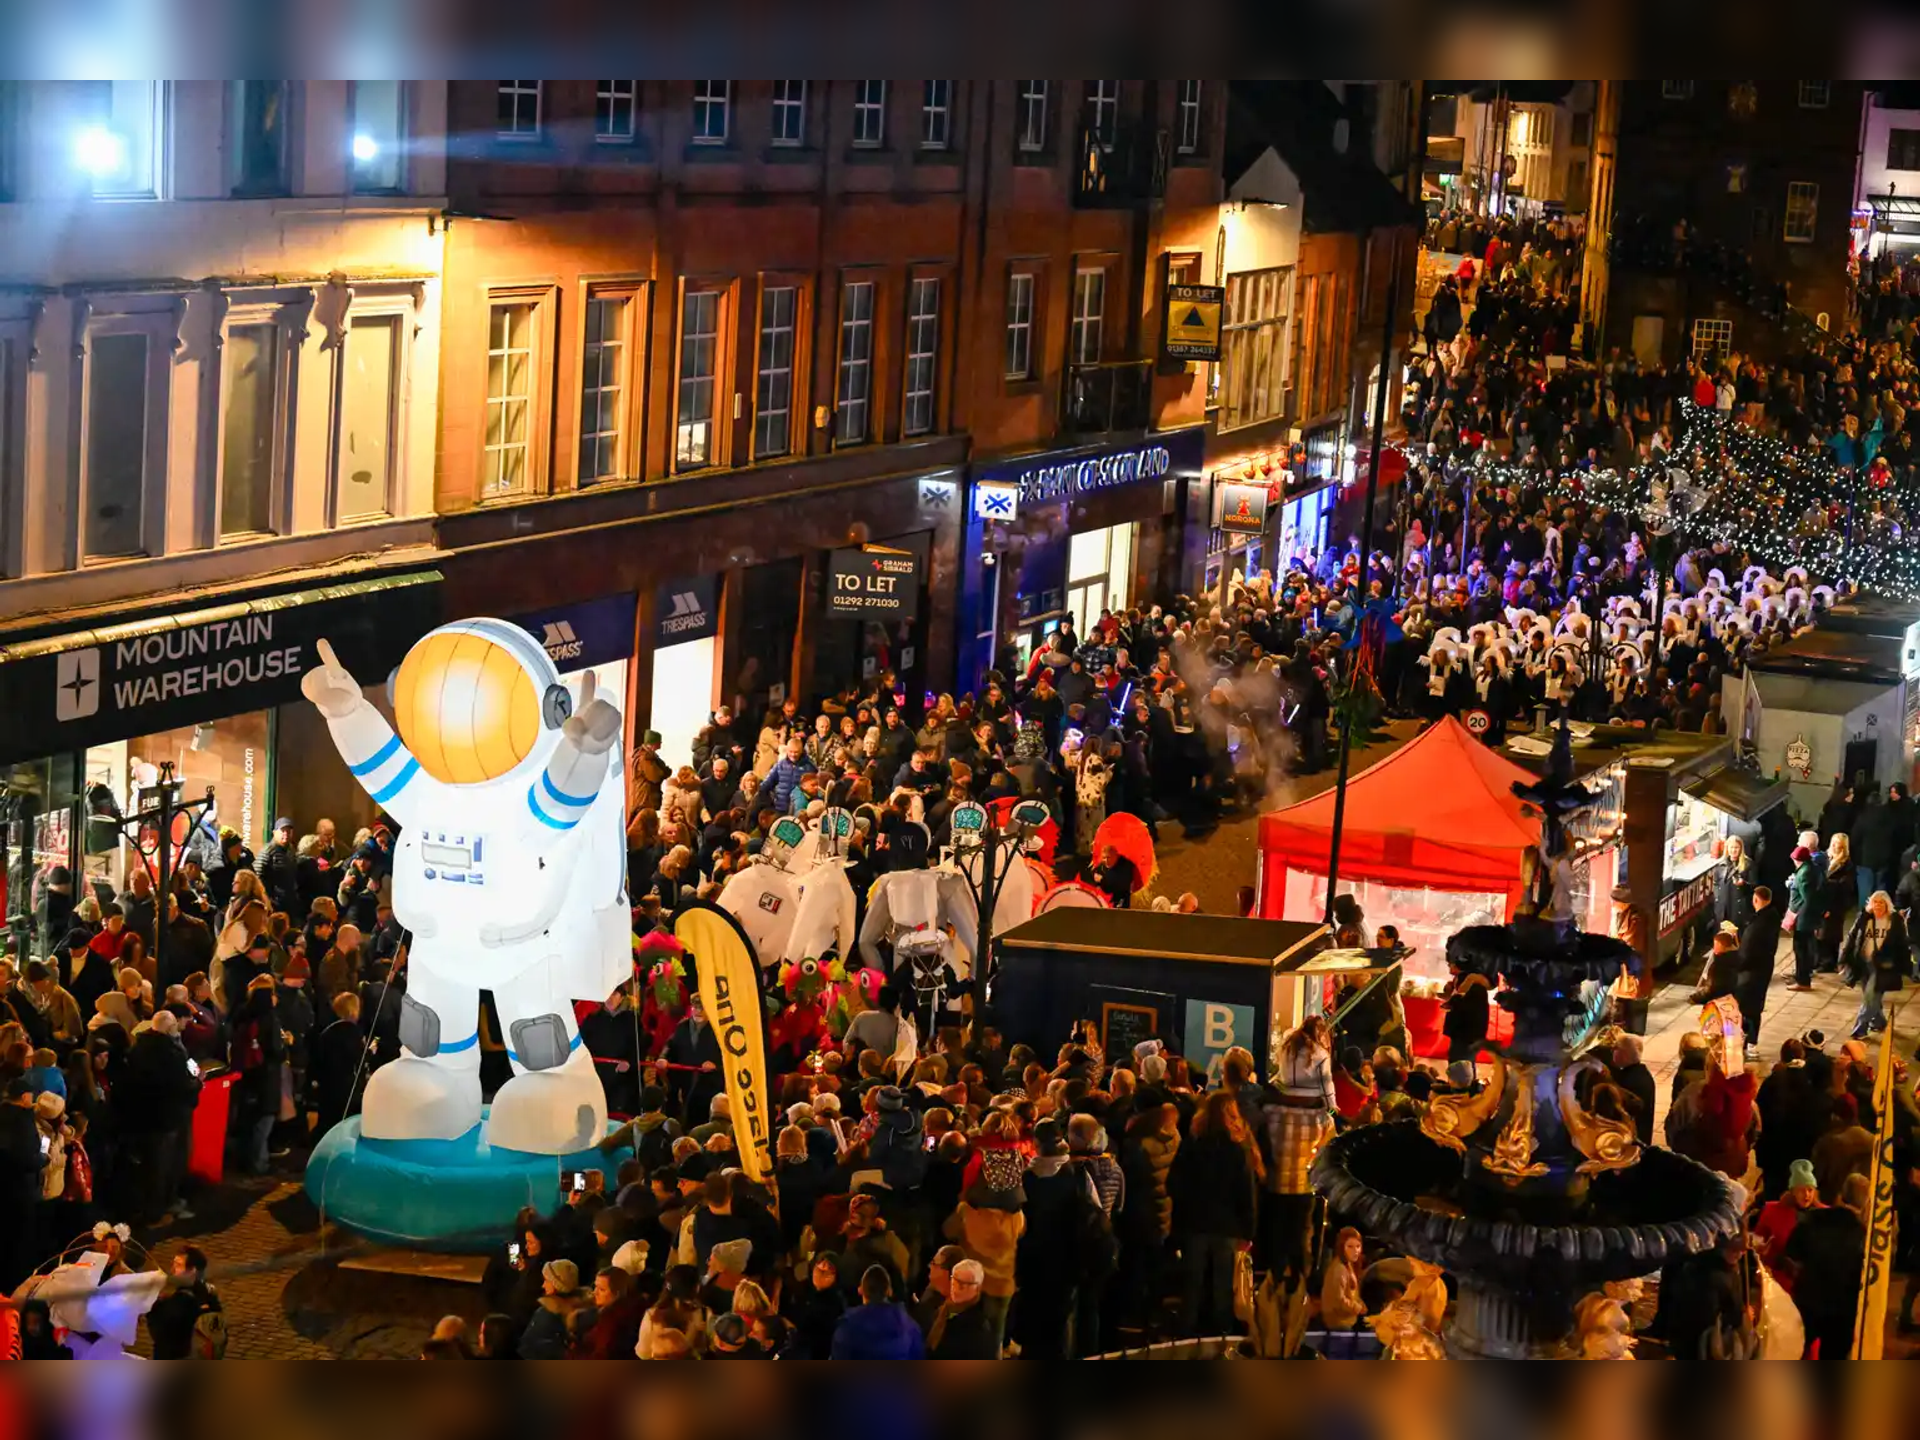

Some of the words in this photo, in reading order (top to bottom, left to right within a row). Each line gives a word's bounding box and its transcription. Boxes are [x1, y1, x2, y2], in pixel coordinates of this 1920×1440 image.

[1177, 287, 1193, 297] TO
[1099, 446, 1170, 487] SCOTLAND
[835, 573, 861, 591] TO
[866, 575, 897, 593] LET
[833, 596, 863, 606] 01292
[661, 611, 707, 634] TRESPASS
[115, 614, 273, 670] MOUNTAIN
[113, 647, 302, 710] WAREHOUSE
[1470, 716, 1487, 728] 20
[1659, 893, 1677, 931] THE
